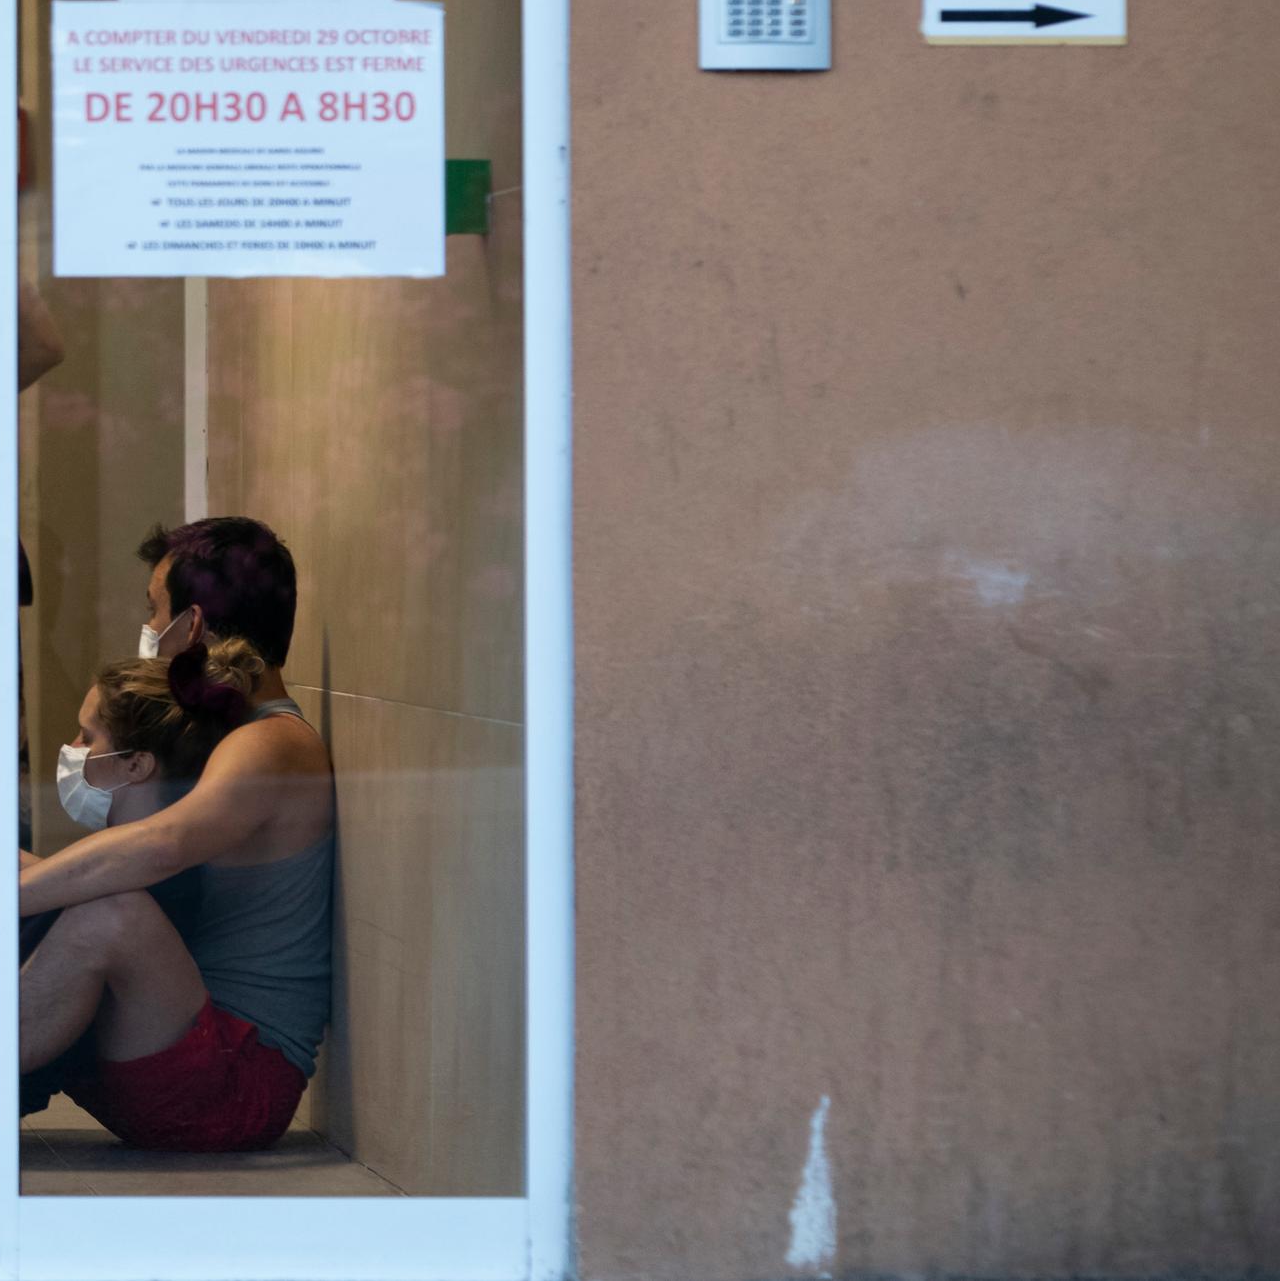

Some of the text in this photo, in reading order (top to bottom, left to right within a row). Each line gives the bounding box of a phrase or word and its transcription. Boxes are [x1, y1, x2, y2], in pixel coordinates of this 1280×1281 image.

[67, 30, 431, 46] A COMPTER DU VENDREDI 29 OCTOBRE
[74, 57, 424, 73] LE SERVICE DES URGENCES EST FERME
[86, 92, 416, 122] DE 20H30 A 8H30
